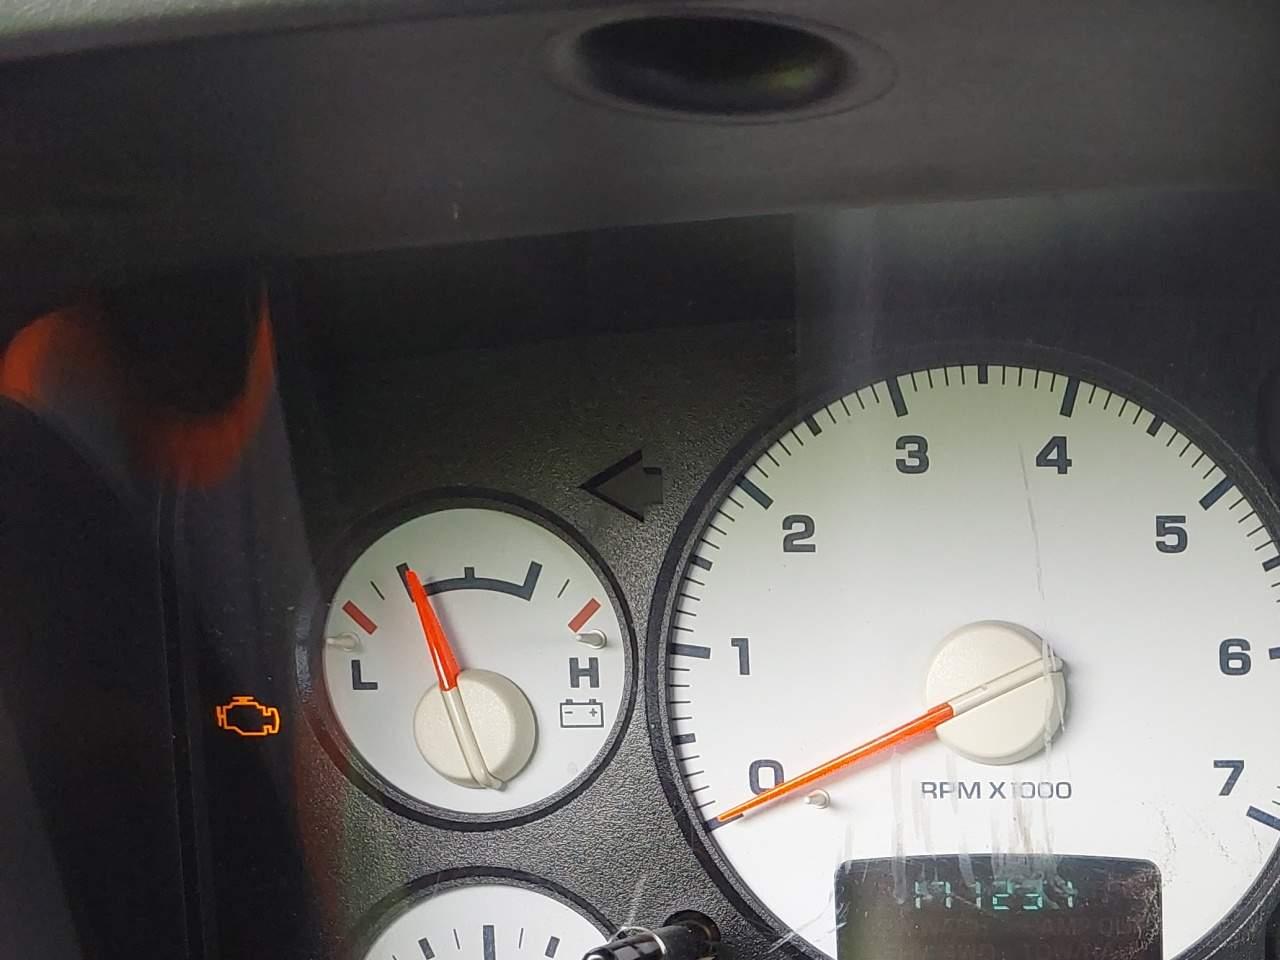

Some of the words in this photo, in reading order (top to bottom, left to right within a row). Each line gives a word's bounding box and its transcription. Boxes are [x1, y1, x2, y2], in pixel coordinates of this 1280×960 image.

[896, 435, 929, 474] 3
[1036, 436, 1072, 474] 4
[782, 515, 815, 552] 2
[1156, 516, 1187, 553] 5
[569, 657, 599, 688] H
[731, 638, 750, 675] 1
[1219, 639, 1251, 675] 6
[351, 660, 378, 690] L
[749, 759, 784, 795] 0
[922, 782, 980, 799] RPM
[1214, 760, 1244, 796] 7
